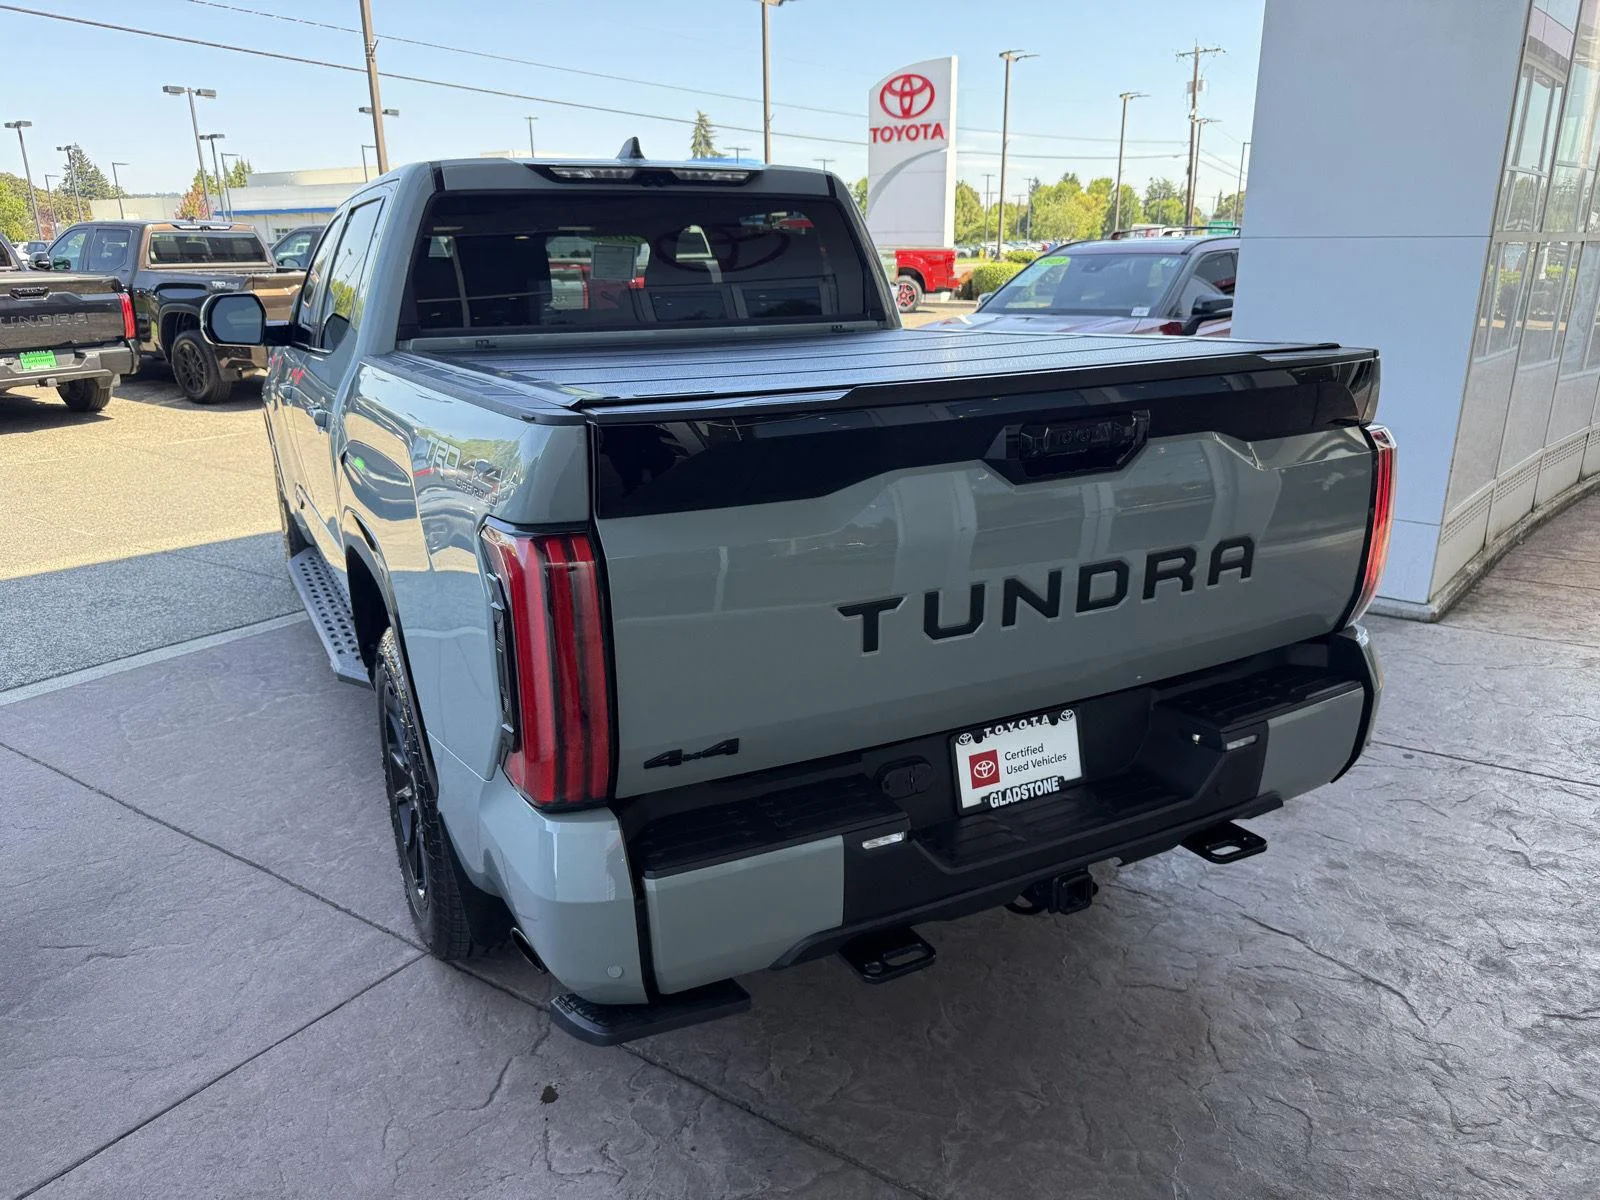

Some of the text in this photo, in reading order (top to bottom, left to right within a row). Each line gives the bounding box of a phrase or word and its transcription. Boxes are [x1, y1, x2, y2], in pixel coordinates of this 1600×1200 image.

[869, 122, 945, 144] TOYOTA
[425, 434, 461, 477] TRD
[837, 535, 1255, 655] TUNDRA
[984, 714, 1051, 738] TOYOTA
[1004, 743, 1044, 761] Certified
[1006, 752, 1067, 775] Used Vehicles
[989, 776, 1060, 808] GLADSTONE
